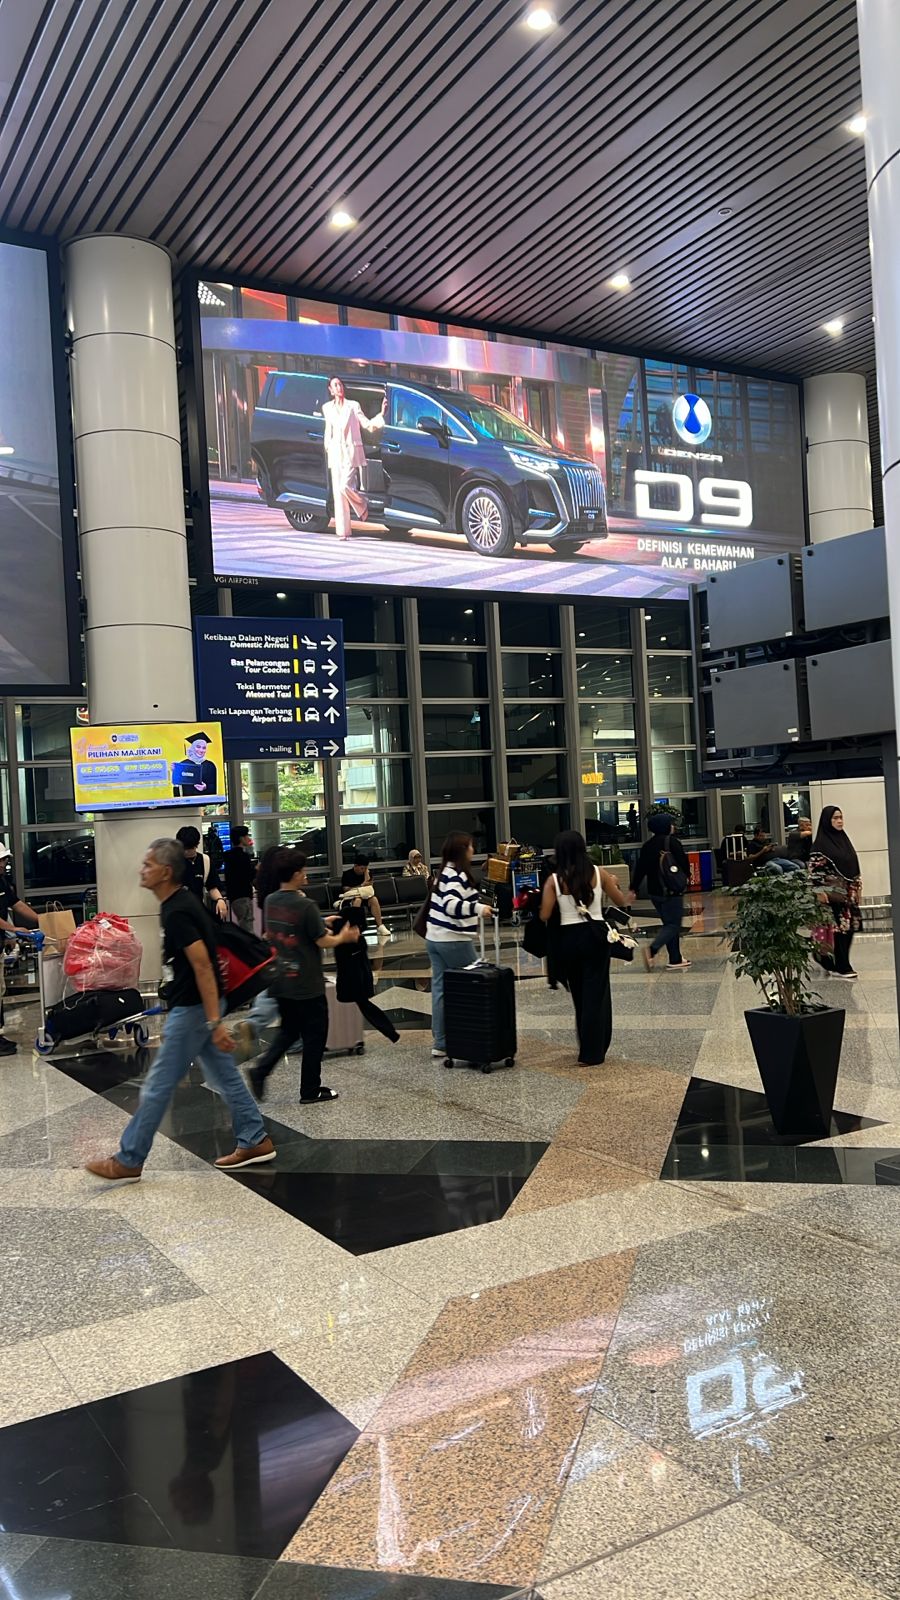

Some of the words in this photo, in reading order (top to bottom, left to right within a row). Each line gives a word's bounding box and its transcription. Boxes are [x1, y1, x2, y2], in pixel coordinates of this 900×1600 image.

[634, 469, 754, 528] D9
[637, 538, 683, 555] DEFINISI
[687, 542, 755, 559] KEMEWAHAN
[661, 556, 688, 569] ALAF
[228, 576, 259, 586] AIRPORTS
[204, 633, 237, 642] Ketibaan
[238, 634, 263, 642] Dalam
[264, 634, 289, 644] Negeri
[229, 641, 263, 649] Domestic
[263, 641, 290, 649] Arrivals
[230, 658, 245, 666] Bas
[245, 658, 290, 669] Pelancongan
[244, 666, 261, 674] Tour
[262, 666, 291, 674] Coaches
[235, 682, 255, 690] Teksi
[256, 683, 292, 691] Bermeter
[245, 690, 276, 699] Metered
[276, 690, 292, 699] Taxi
[208, 707, 228, 716] Teksi
[228, 707, 263, 718] Lapangan
[263, 707, 293, 717] Terbang
[251, 715, 277, 724] Airport
[277, 715, 293, 723] Taxi
[86, 749, 120, 758] PILIHAN
[269, 744, 293, 754] hailing
